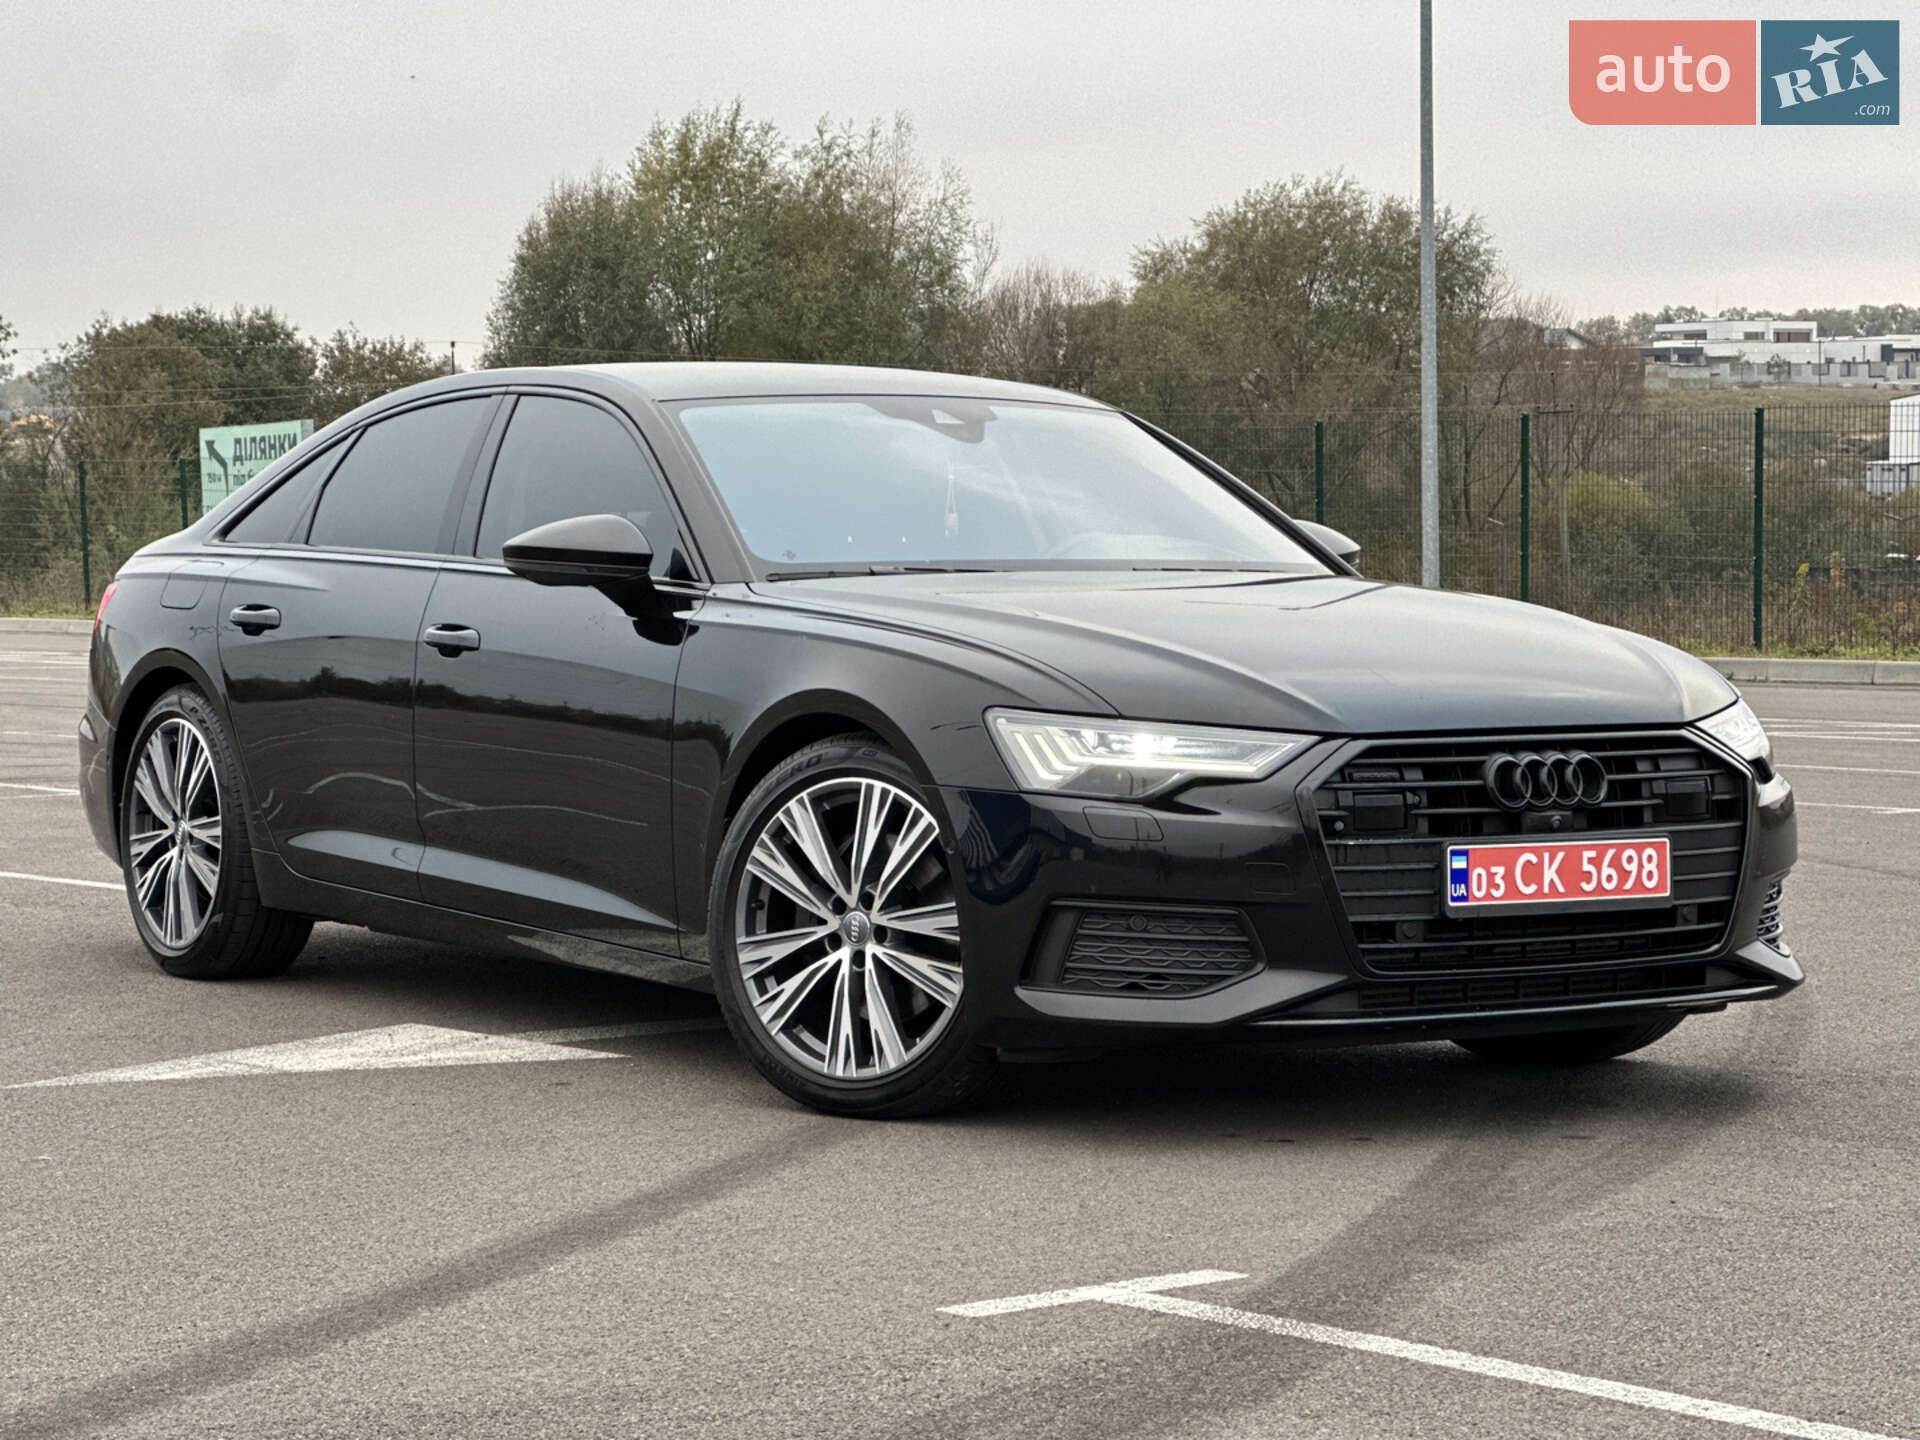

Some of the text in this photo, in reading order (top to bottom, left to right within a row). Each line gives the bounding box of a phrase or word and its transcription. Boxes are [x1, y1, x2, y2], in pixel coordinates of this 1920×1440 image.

[232, 432, 298, 467] ДІЛЯНКИ
[1451, 884, 1468, 897] UA
[1472, 847, 1659, 899] 03 CK 5698
